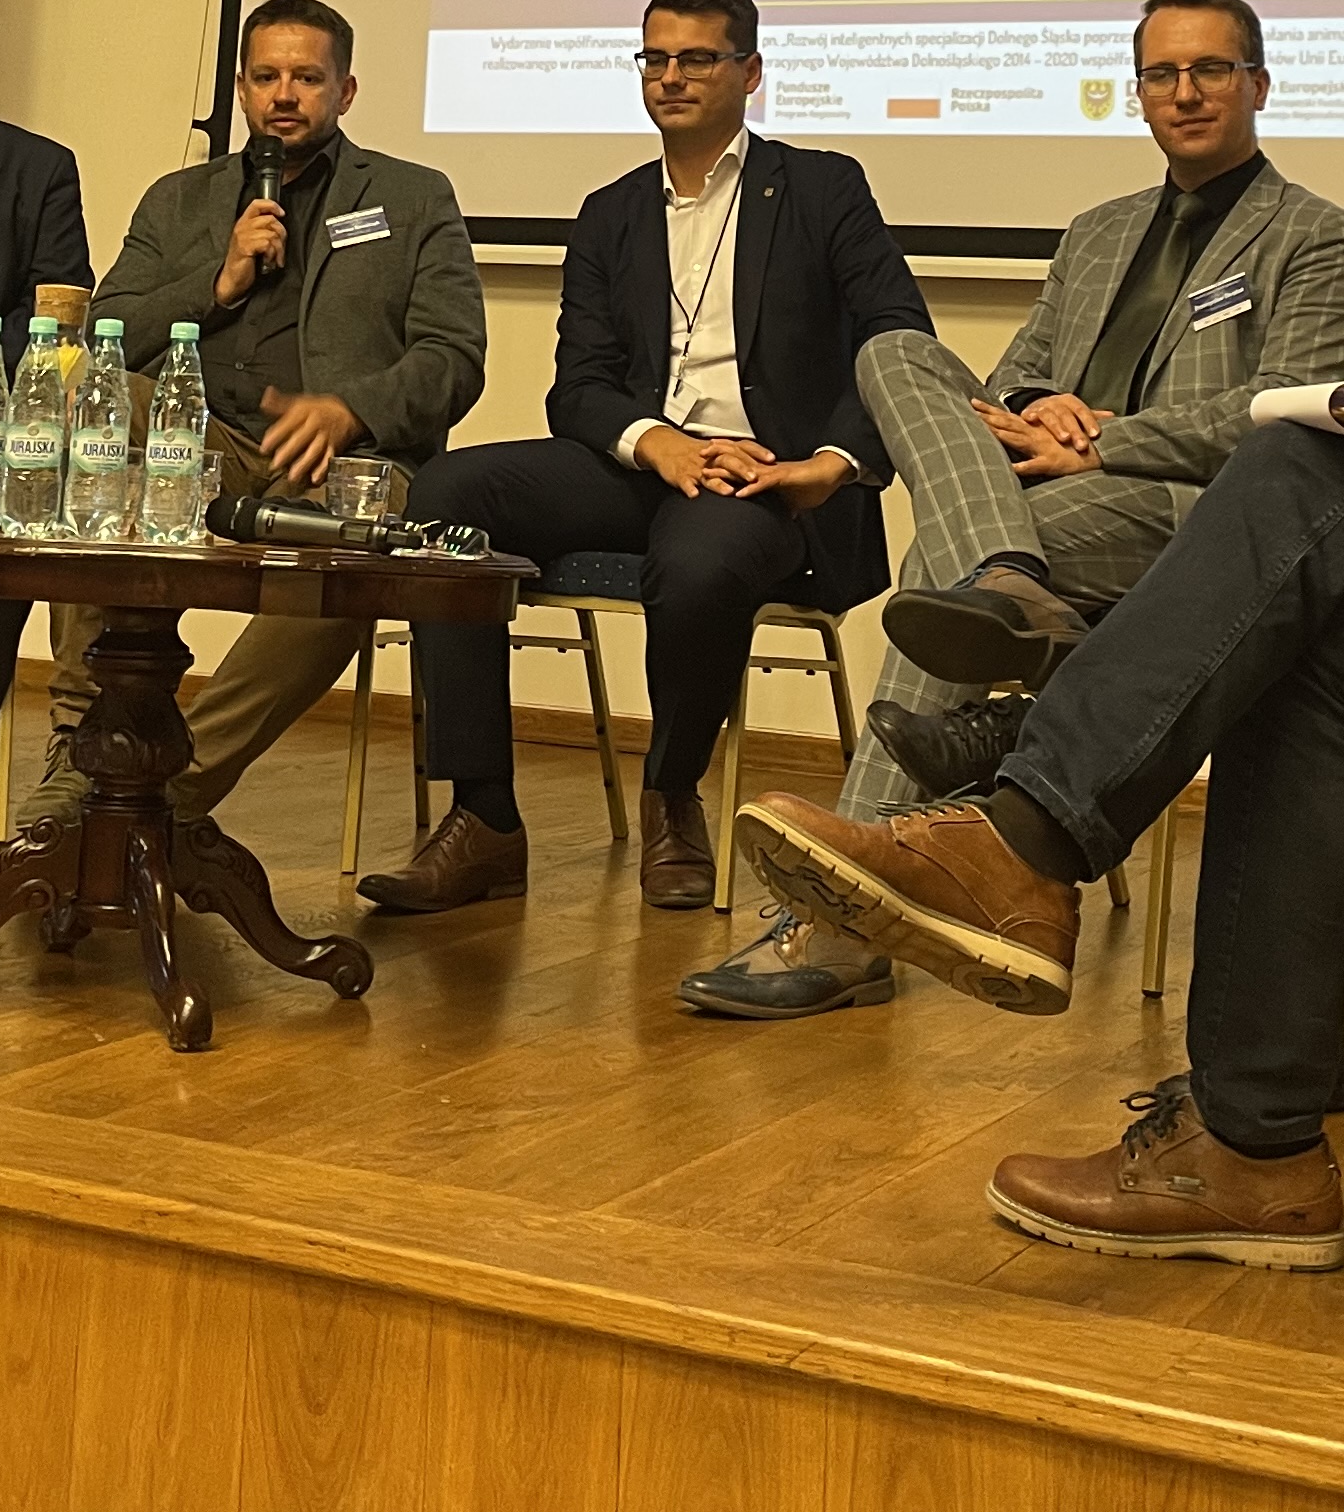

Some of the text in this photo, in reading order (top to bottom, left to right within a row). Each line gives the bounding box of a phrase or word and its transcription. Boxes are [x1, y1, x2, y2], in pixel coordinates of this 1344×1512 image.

[988, 30, 1038, 47] Dolnego
[1044, 52, 1078, 66] 2020
[10, 440, 55, 454] JURAJSKA
